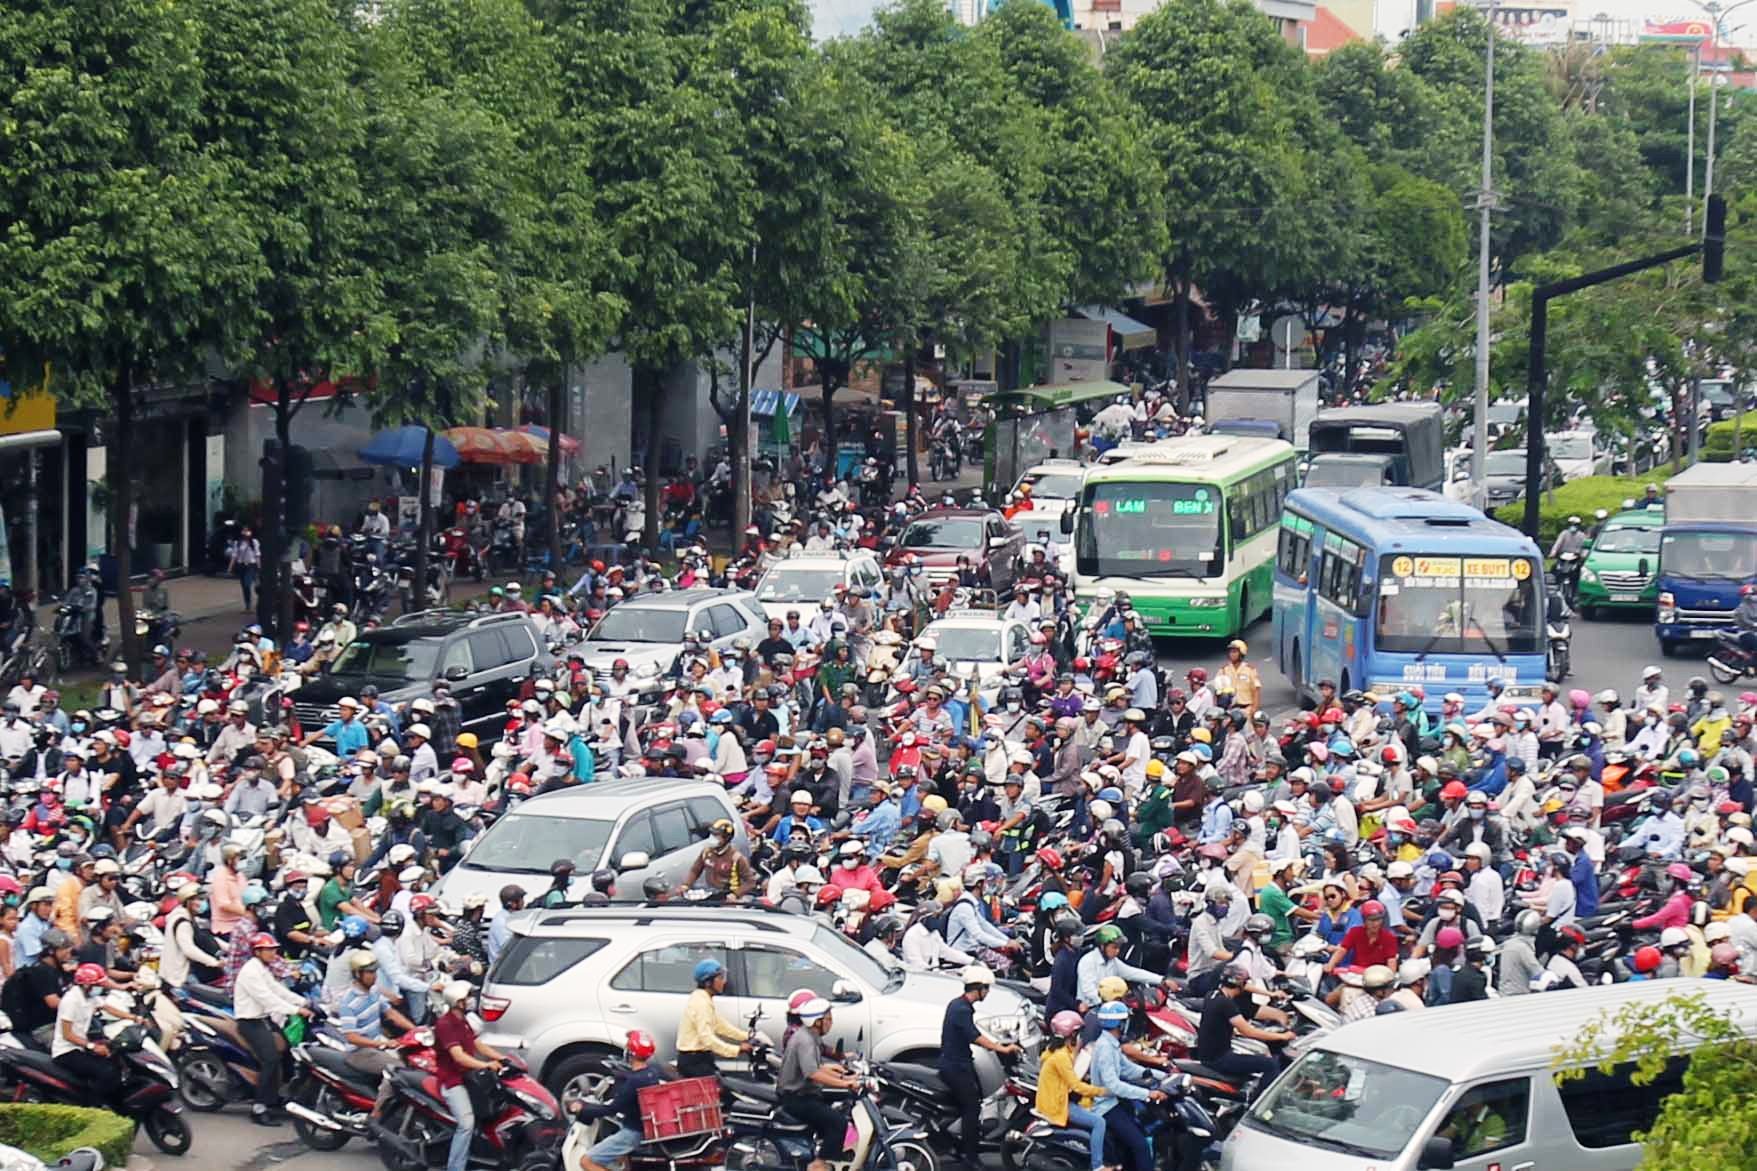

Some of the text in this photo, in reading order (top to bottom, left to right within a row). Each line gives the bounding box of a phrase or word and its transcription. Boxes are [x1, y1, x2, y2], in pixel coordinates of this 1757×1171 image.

[1115, 500, 1145, 513] LAM
[1397, 561, 1410, 573] 12
[1515, 563, 1528, 575] 12
